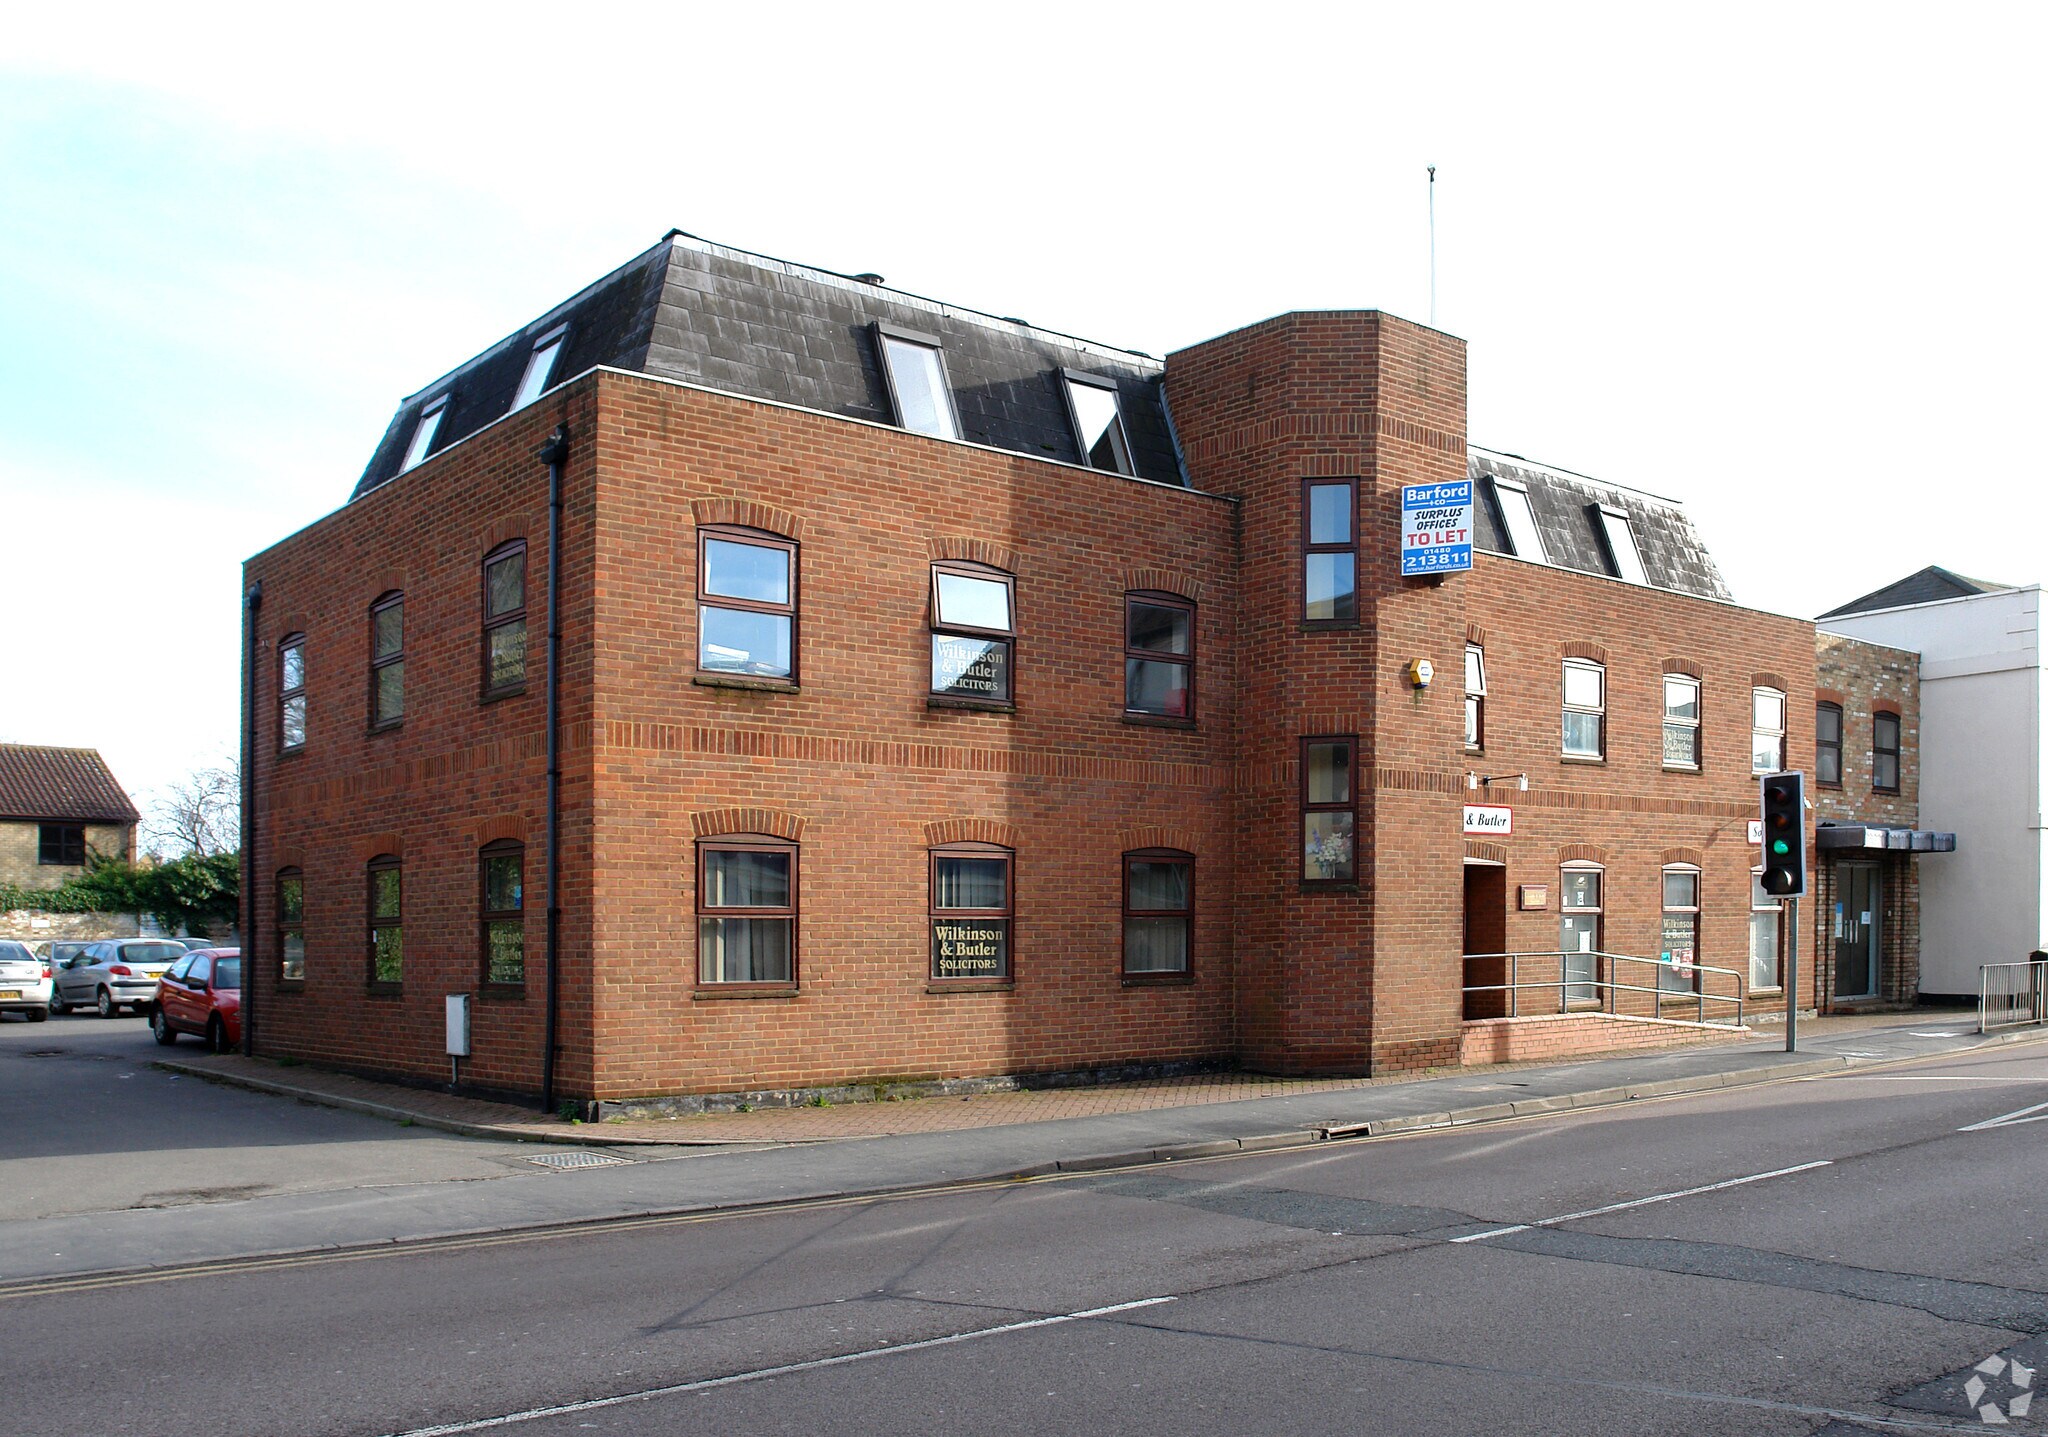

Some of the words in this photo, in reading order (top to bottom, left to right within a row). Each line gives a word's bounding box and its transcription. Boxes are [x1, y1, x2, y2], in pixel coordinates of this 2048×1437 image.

[1407, 483, 1468, 501] Barford
[1414, 507, 1464, 521] SURPLUS
[1416, 518, 1458, 531] OFFICES
[1407, 533, 1430, 546] TO
[1435, 529, 1467, 544] LET
[1423, 547, 1451, 555] 01480
[1406, 552, 1469, 567] 213811
[937, 643, 1003, 664] Wilkinson
[941, 658, 953, 673] &
[957, 661, 997, 678] Butler
[941, 676, 998, 691] SOLICITORS
[1466, 813, 1474, 826] &
[1478, 813, 1507, 827] Butler
[935, 926, 1003, 941] Wilkinson
[941, 942, 953, 956] &
[956, 942, 997, 956] Butler
[940, 959, 997, 969] SOLICITORS
